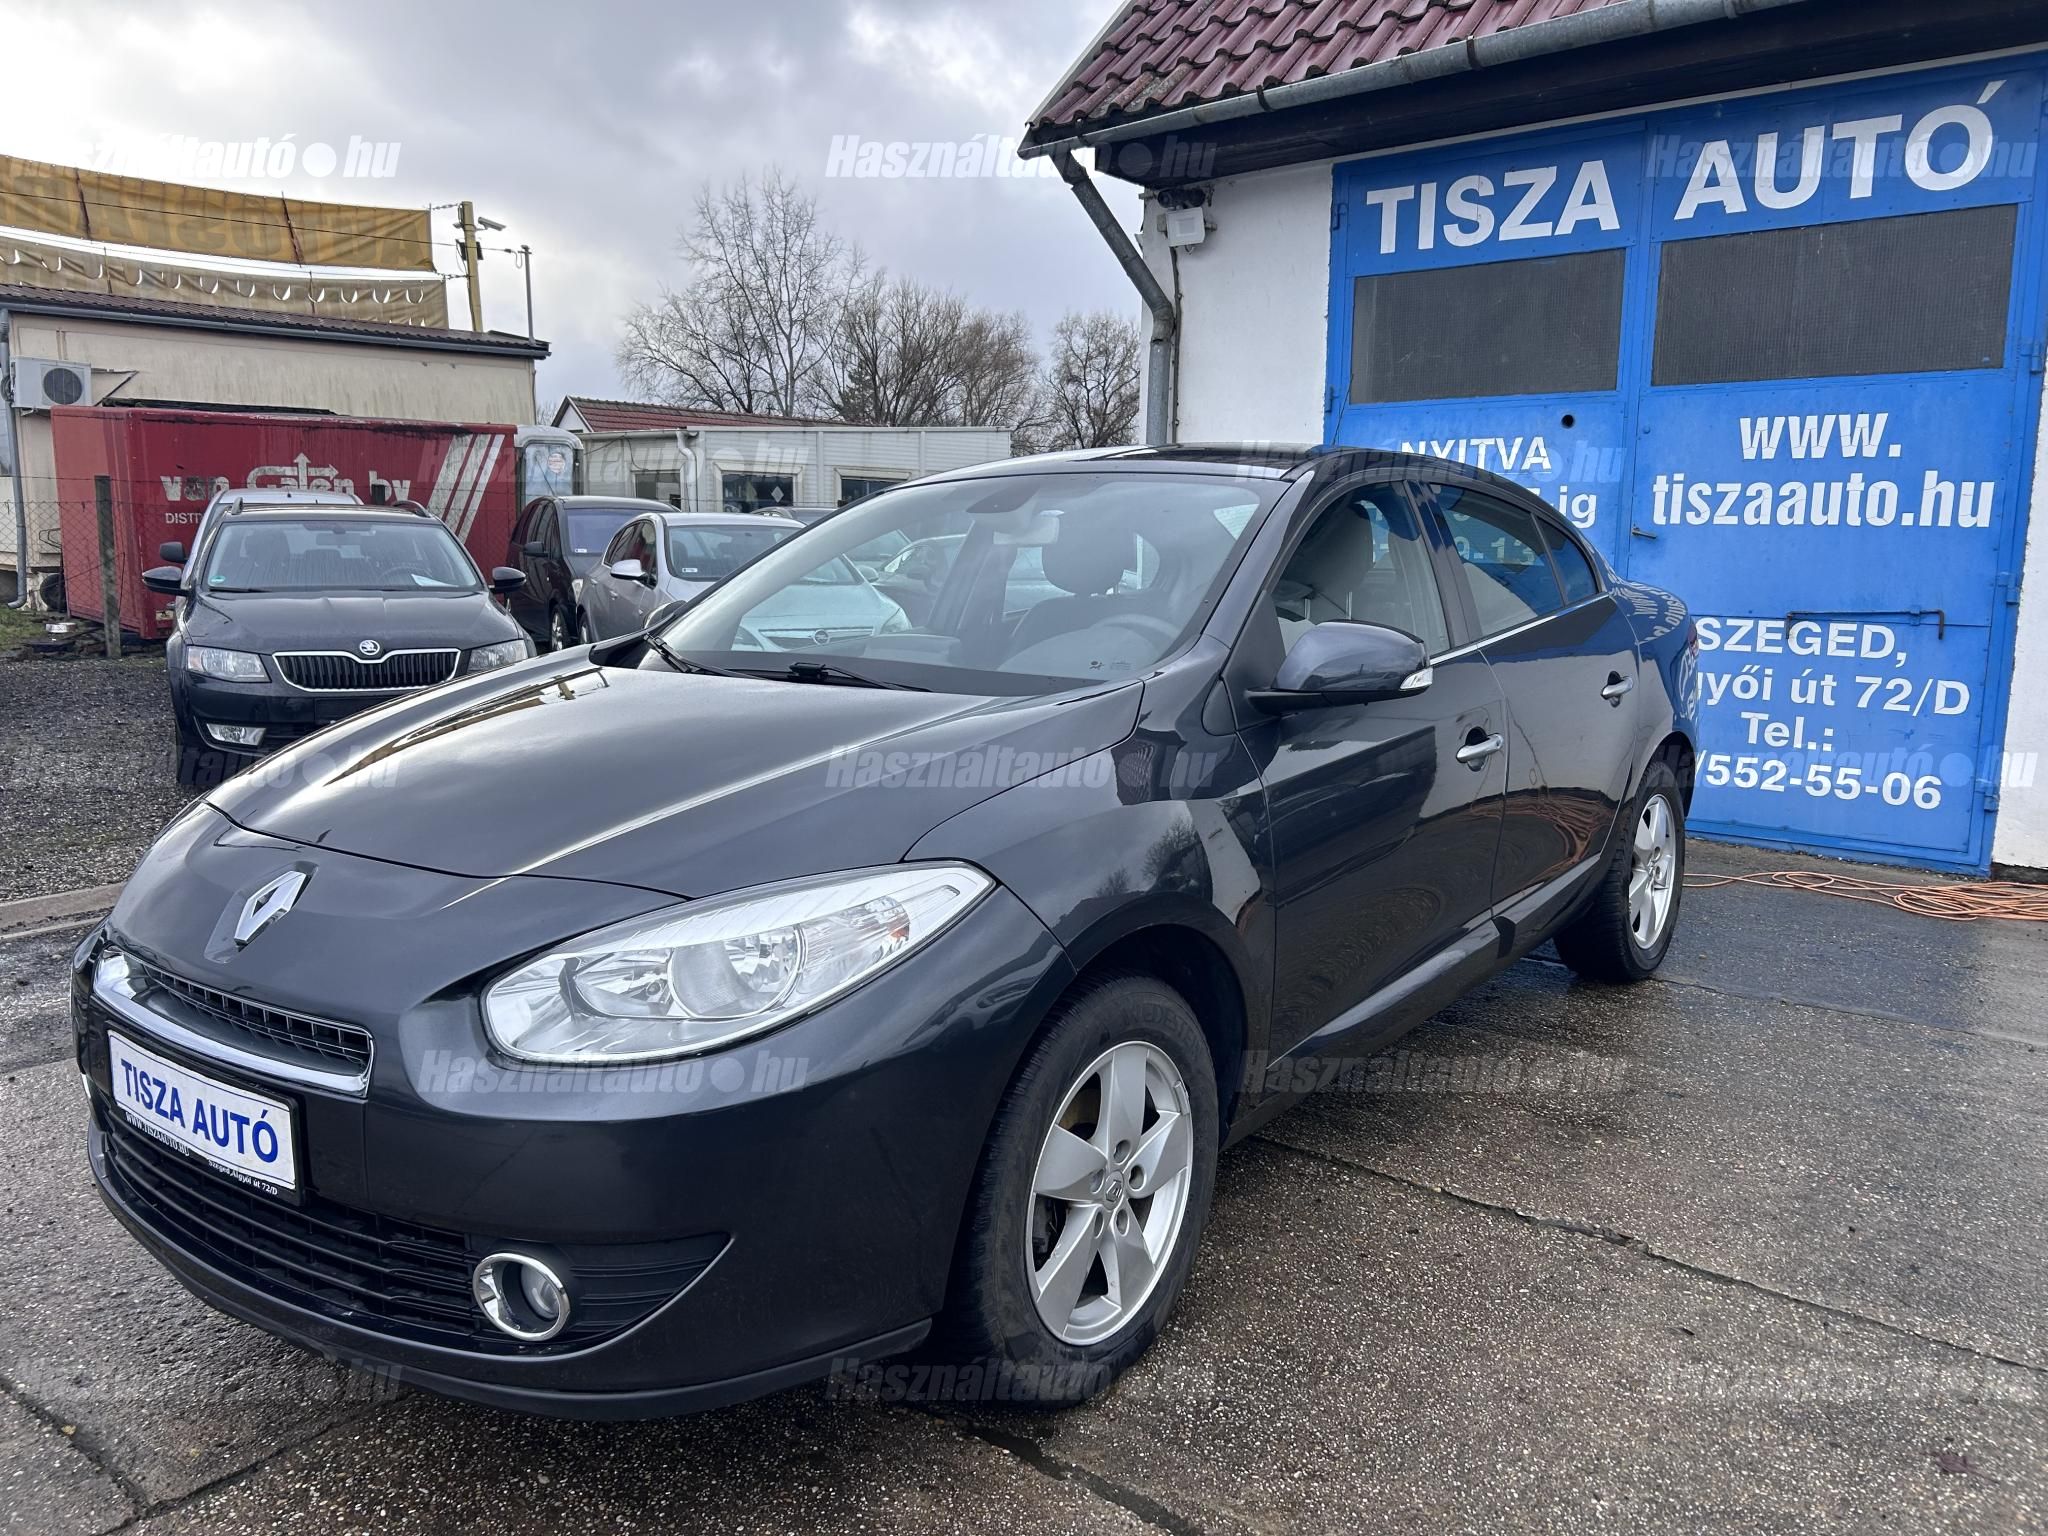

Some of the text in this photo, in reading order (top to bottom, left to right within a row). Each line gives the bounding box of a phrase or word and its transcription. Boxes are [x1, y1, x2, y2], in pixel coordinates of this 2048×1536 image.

[1366, 79, 2007, 254] TISZA AUTÓ
[160, 475, 229, 501] van
[1652, 470, 1996, 528] tiszaauto.hu
[1695, 617, 1907, 667] SZEGED,
[1790, 668, 1836, 706] út
[1855, 675, 1971, 717] 72/D
[1740, 711, 1835, 752] Tel.:
[121, 1058, 279, 1164] TISZA AUTÓ
